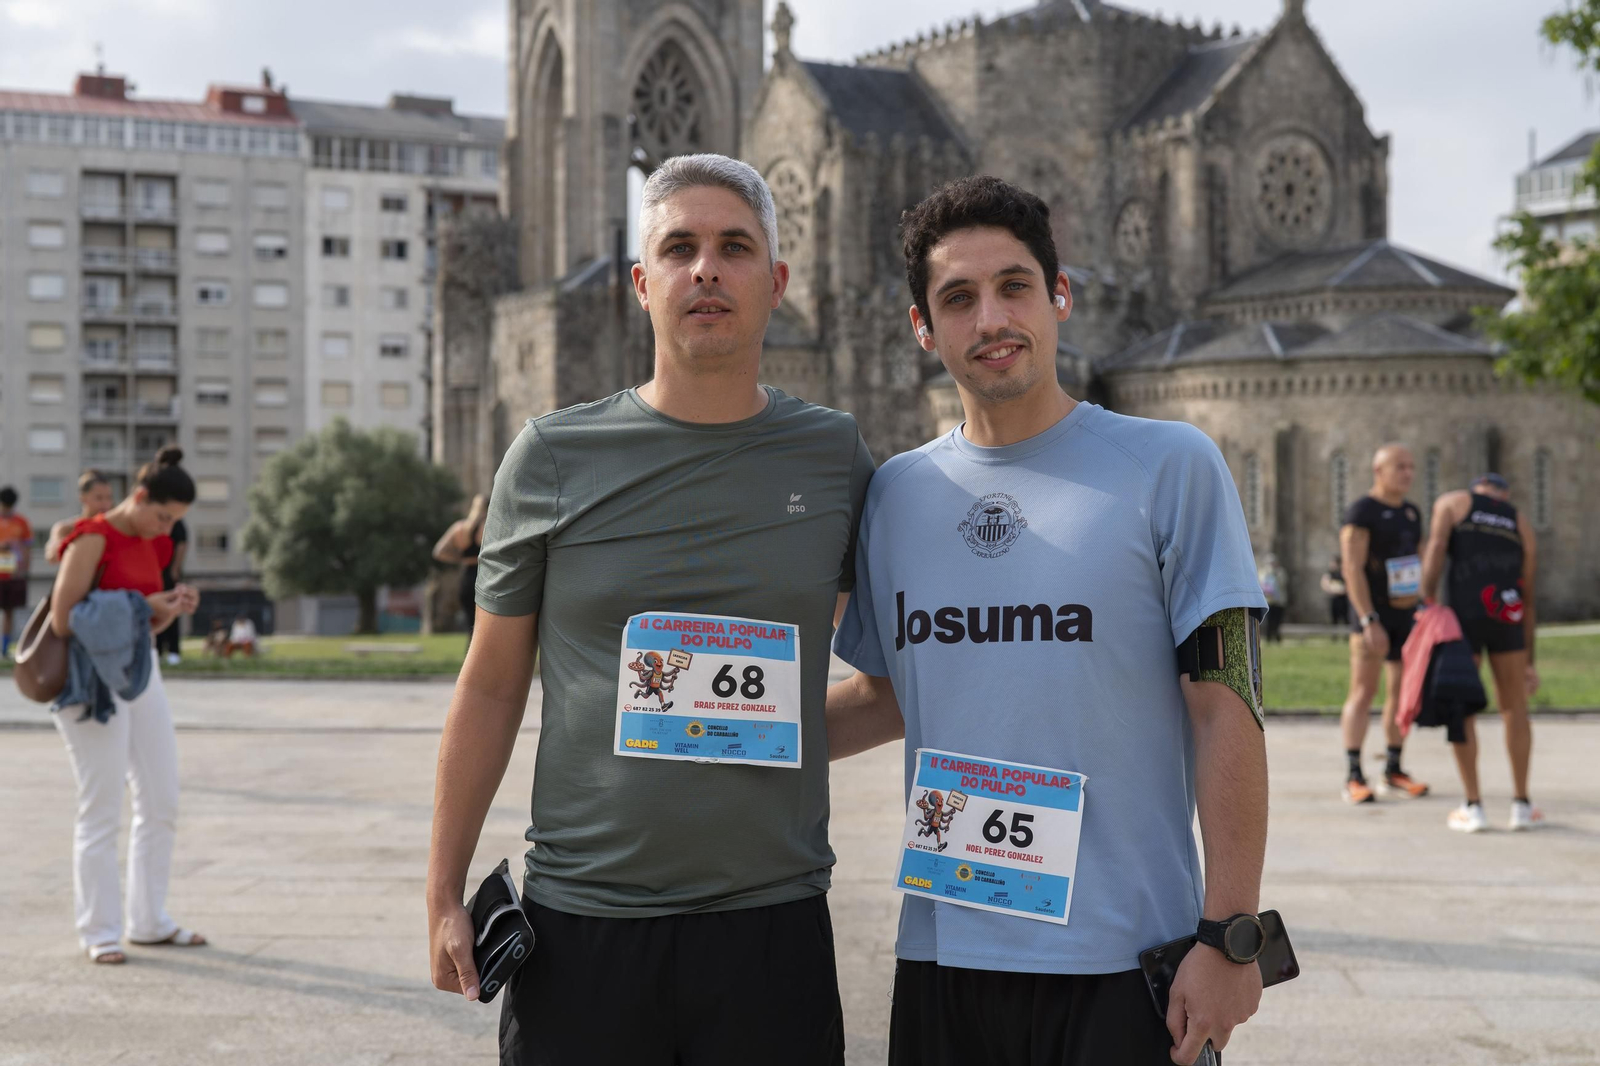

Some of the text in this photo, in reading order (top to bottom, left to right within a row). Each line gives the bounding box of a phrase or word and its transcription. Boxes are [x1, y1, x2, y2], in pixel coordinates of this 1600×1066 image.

[979, 492, 1014, 502] SPORTING
[787, 504, 806, 515] ipso
[895, 591, 1094, 652] Josuma
[640, 618, 787, 641] II CARREIRA POPULAR
[681, 634, 753, 650] DO PULPO
[711, 664, 765, 700] 68
[694, 700, 777, 713] BRAIS PEREZ GONZALEZ
[625, 738, 659, 750] GADIS
[674, 742, 699, 750] VITAMIN
[930, 756, 1072, 790] II CARREIRA POPULAR
[960, 775, 1027, 797] DO PULPO
[982, 809, 1034, 848] 65
[965, 843, 1044, 864] NOEL PEREZ GONZALEZ
[904, 875, 933, 889] GADIS
[945, 884, 967, 893] VITAMIN
[944, 889, 958, 897] WELL
[987, 896, 1013, 906] NOCCO
